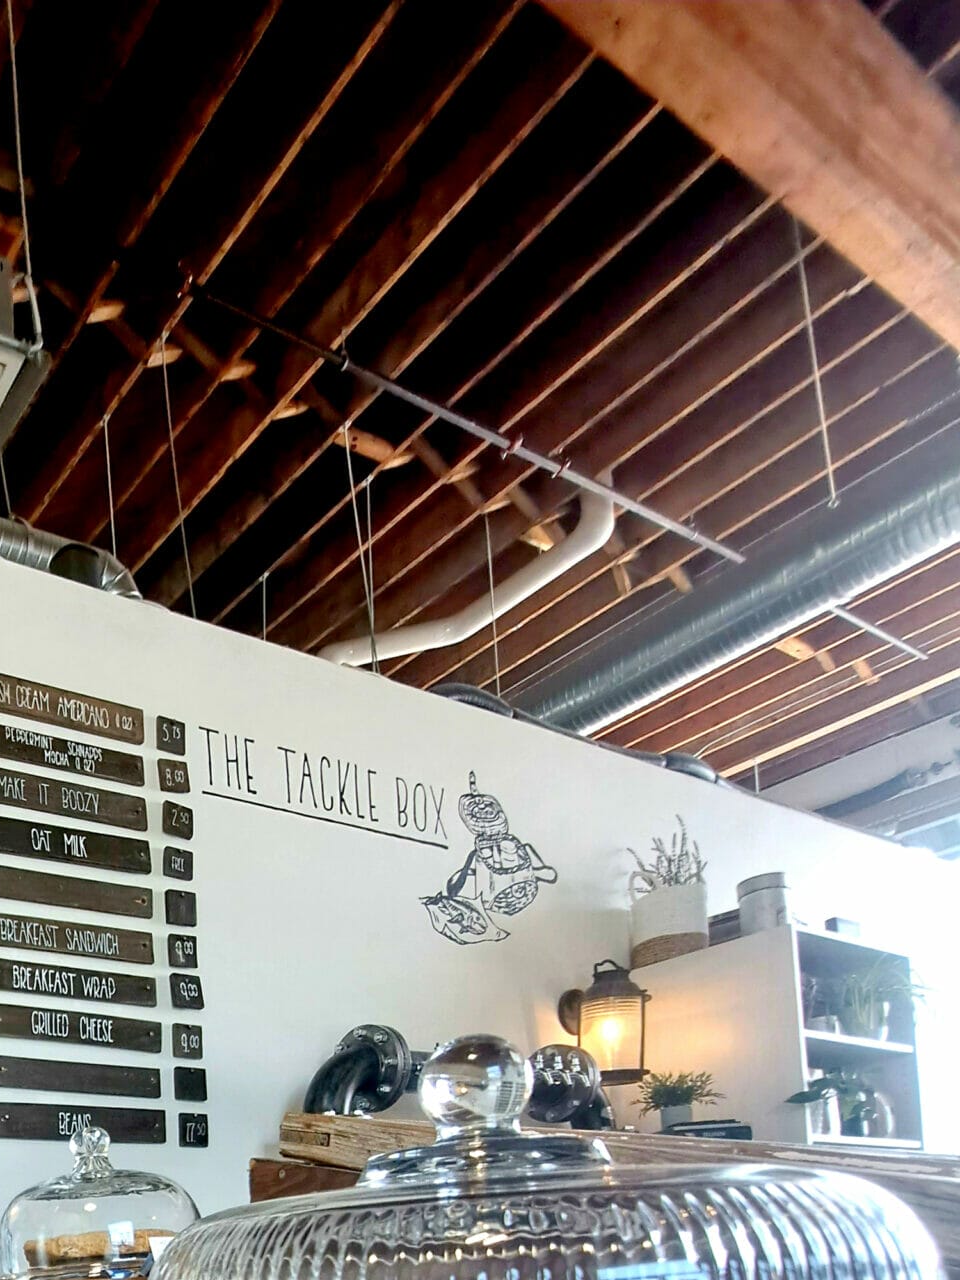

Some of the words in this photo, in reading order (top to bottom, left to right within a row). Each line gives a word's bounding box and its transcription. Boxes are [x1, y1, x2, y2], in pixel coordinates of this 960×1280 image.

[15, 684, 50, 713] CREAM
[57, 696, 110, 729] AMERICANO
[5, 726, 54, 751] PEPPERMINT
[67, 741, 103, 762] SCHNAPPS
[44, 750, 70, 767] MOCHA
[165, 768, 185, 786] 8.00
[198, 725, 258, 795] THE
[277, 745, 380, 823] TACKLE
[396, 776, 448, 840] BOX
[39, 783, 50, 805] IT
[62, 788, 100, 815] BOOZY
[171, 808, 190, 827] 2.50
[31, 827, 52, 852] OAT
[63, 833, 88, 859] MILK
[0, 918, 59, 948] BREAKFAST
[66, 927, 120, 955] SANDWICH
[12, 964, 76, 991] BREAKFAST
[81, 976, 117, 999] WRAP
[31, 1010, 70, 1038] GRILLED
[79, 1015, 115, 1043] CHEESE
[58, 1111, 92, 1135] BEANS
